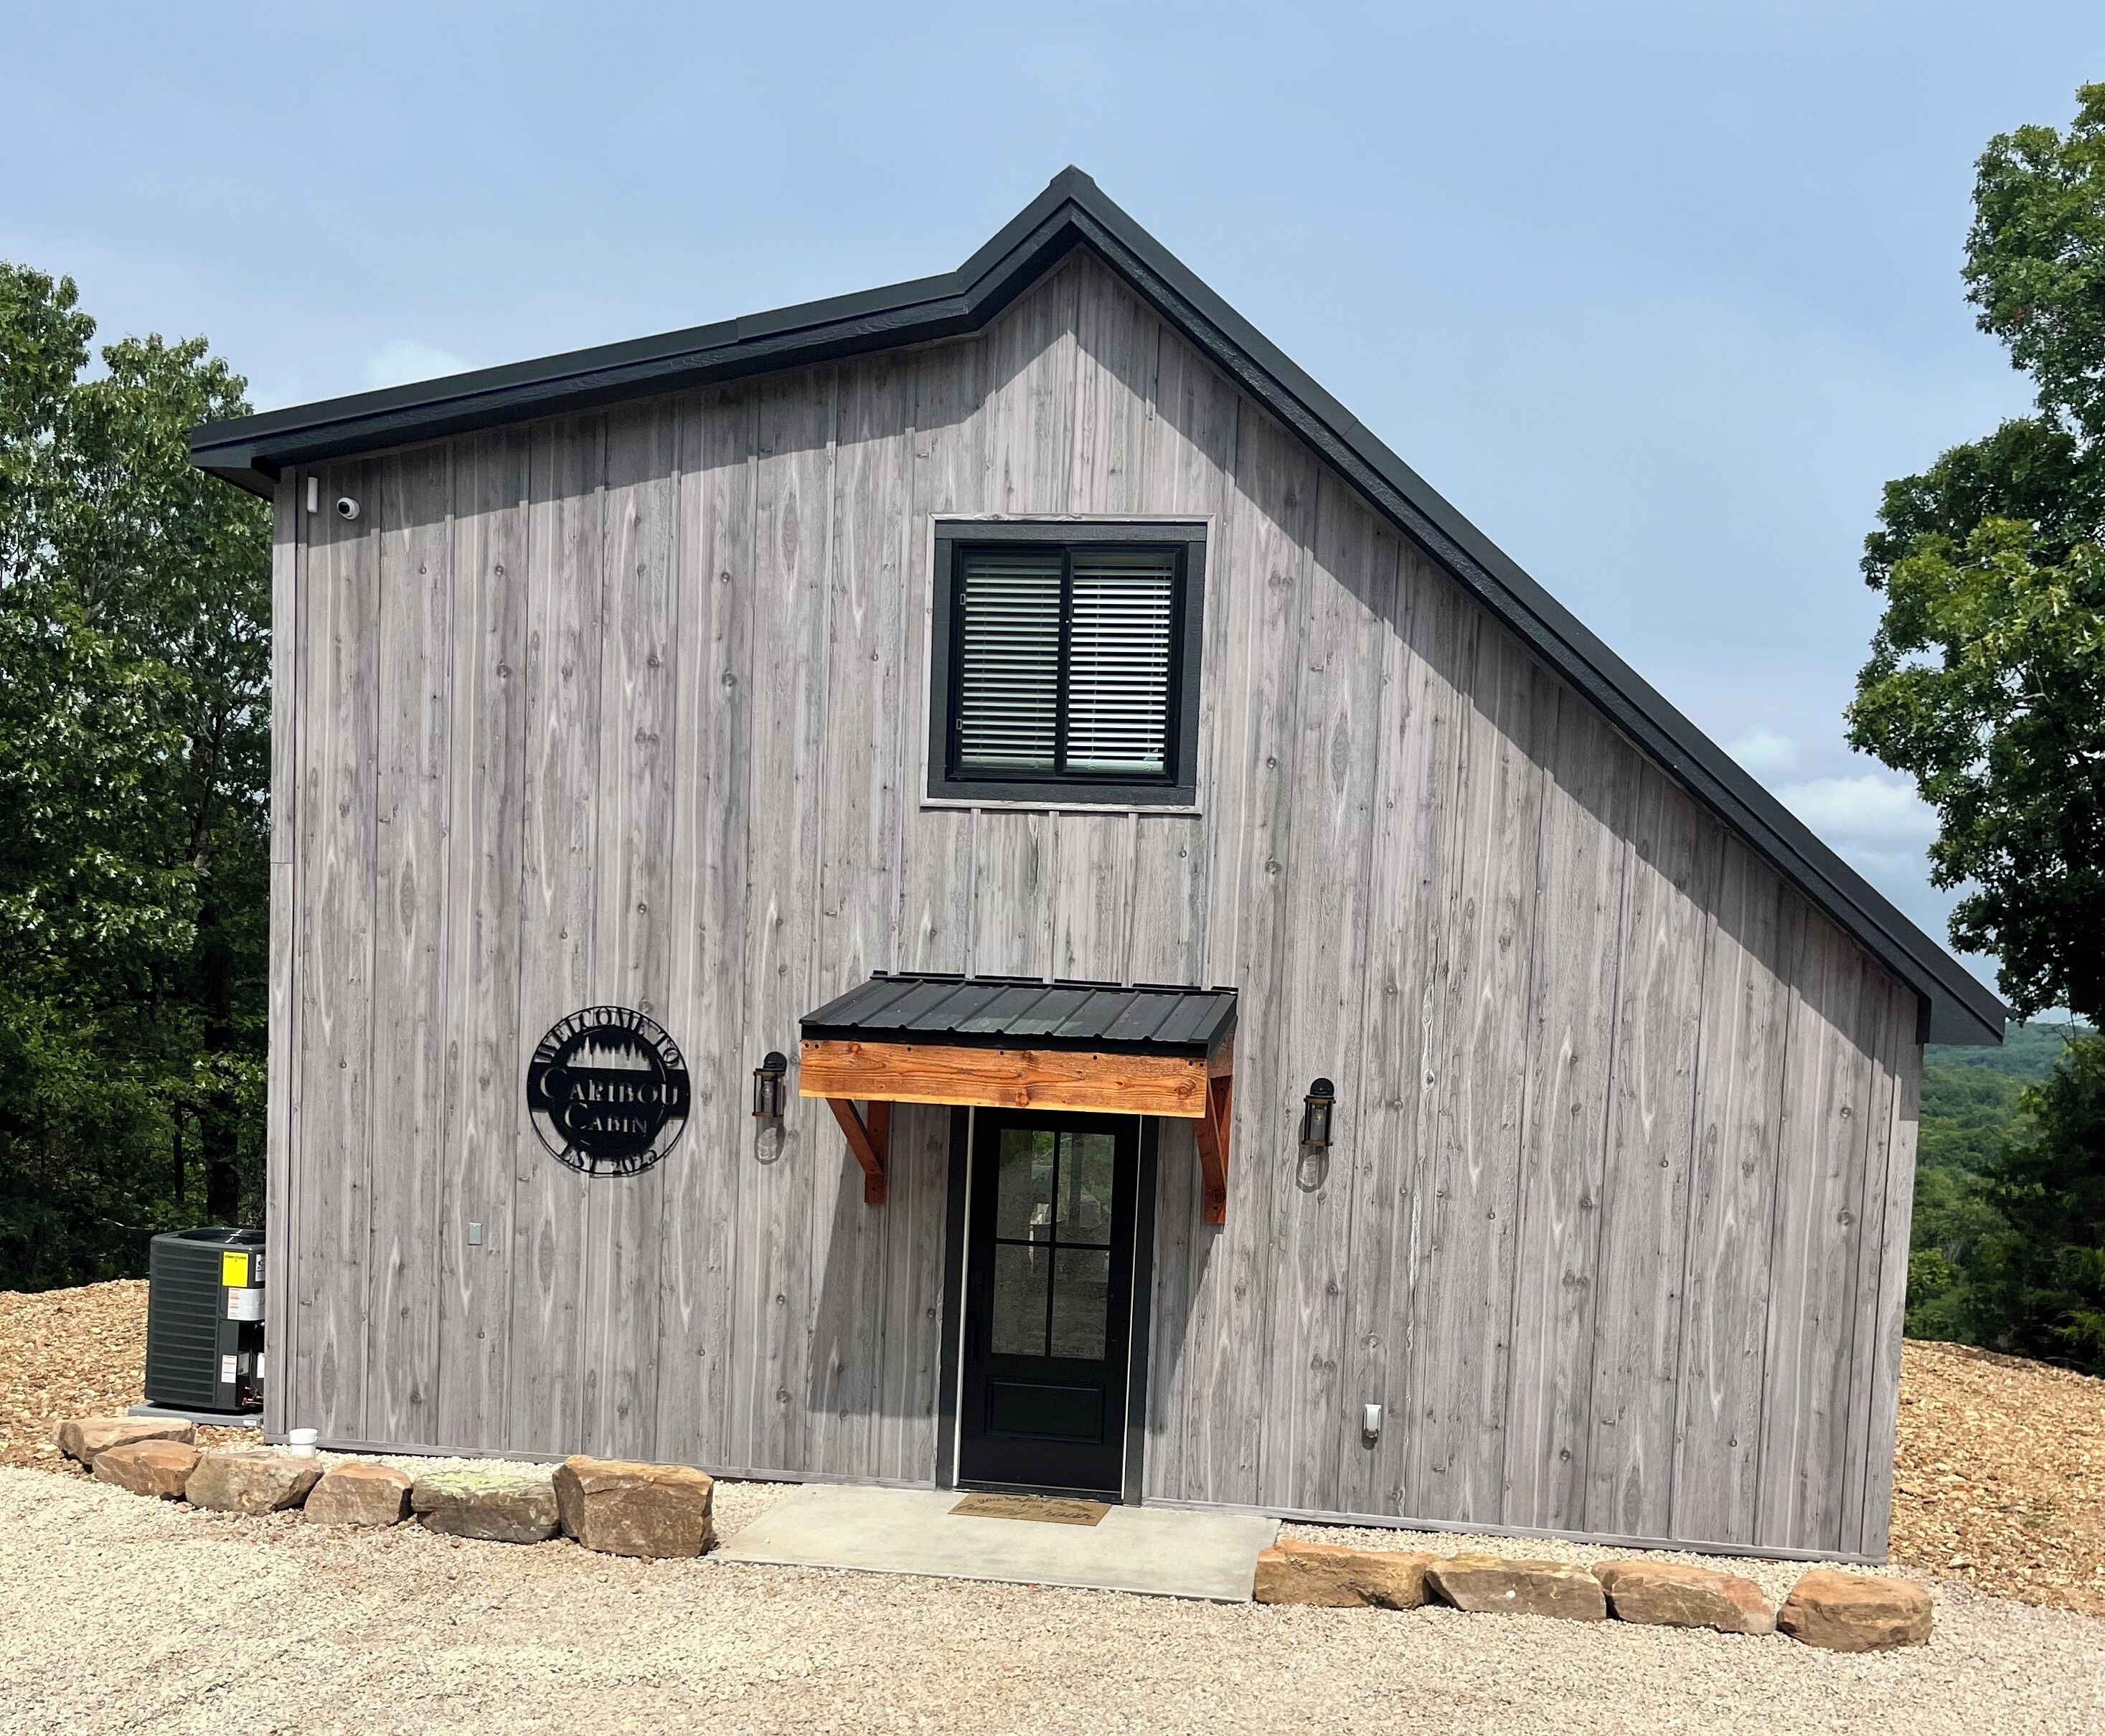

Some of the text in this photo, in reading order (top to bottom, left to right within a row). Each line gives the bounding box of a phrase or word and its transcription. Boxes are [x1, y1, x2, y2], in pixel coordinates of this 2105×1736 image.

[535, 1007, 679, 1064] WELCOME TO
[540, 1067, 678, 1105] CARIBOU
[565, 1103, 647, 1135] CABIN
